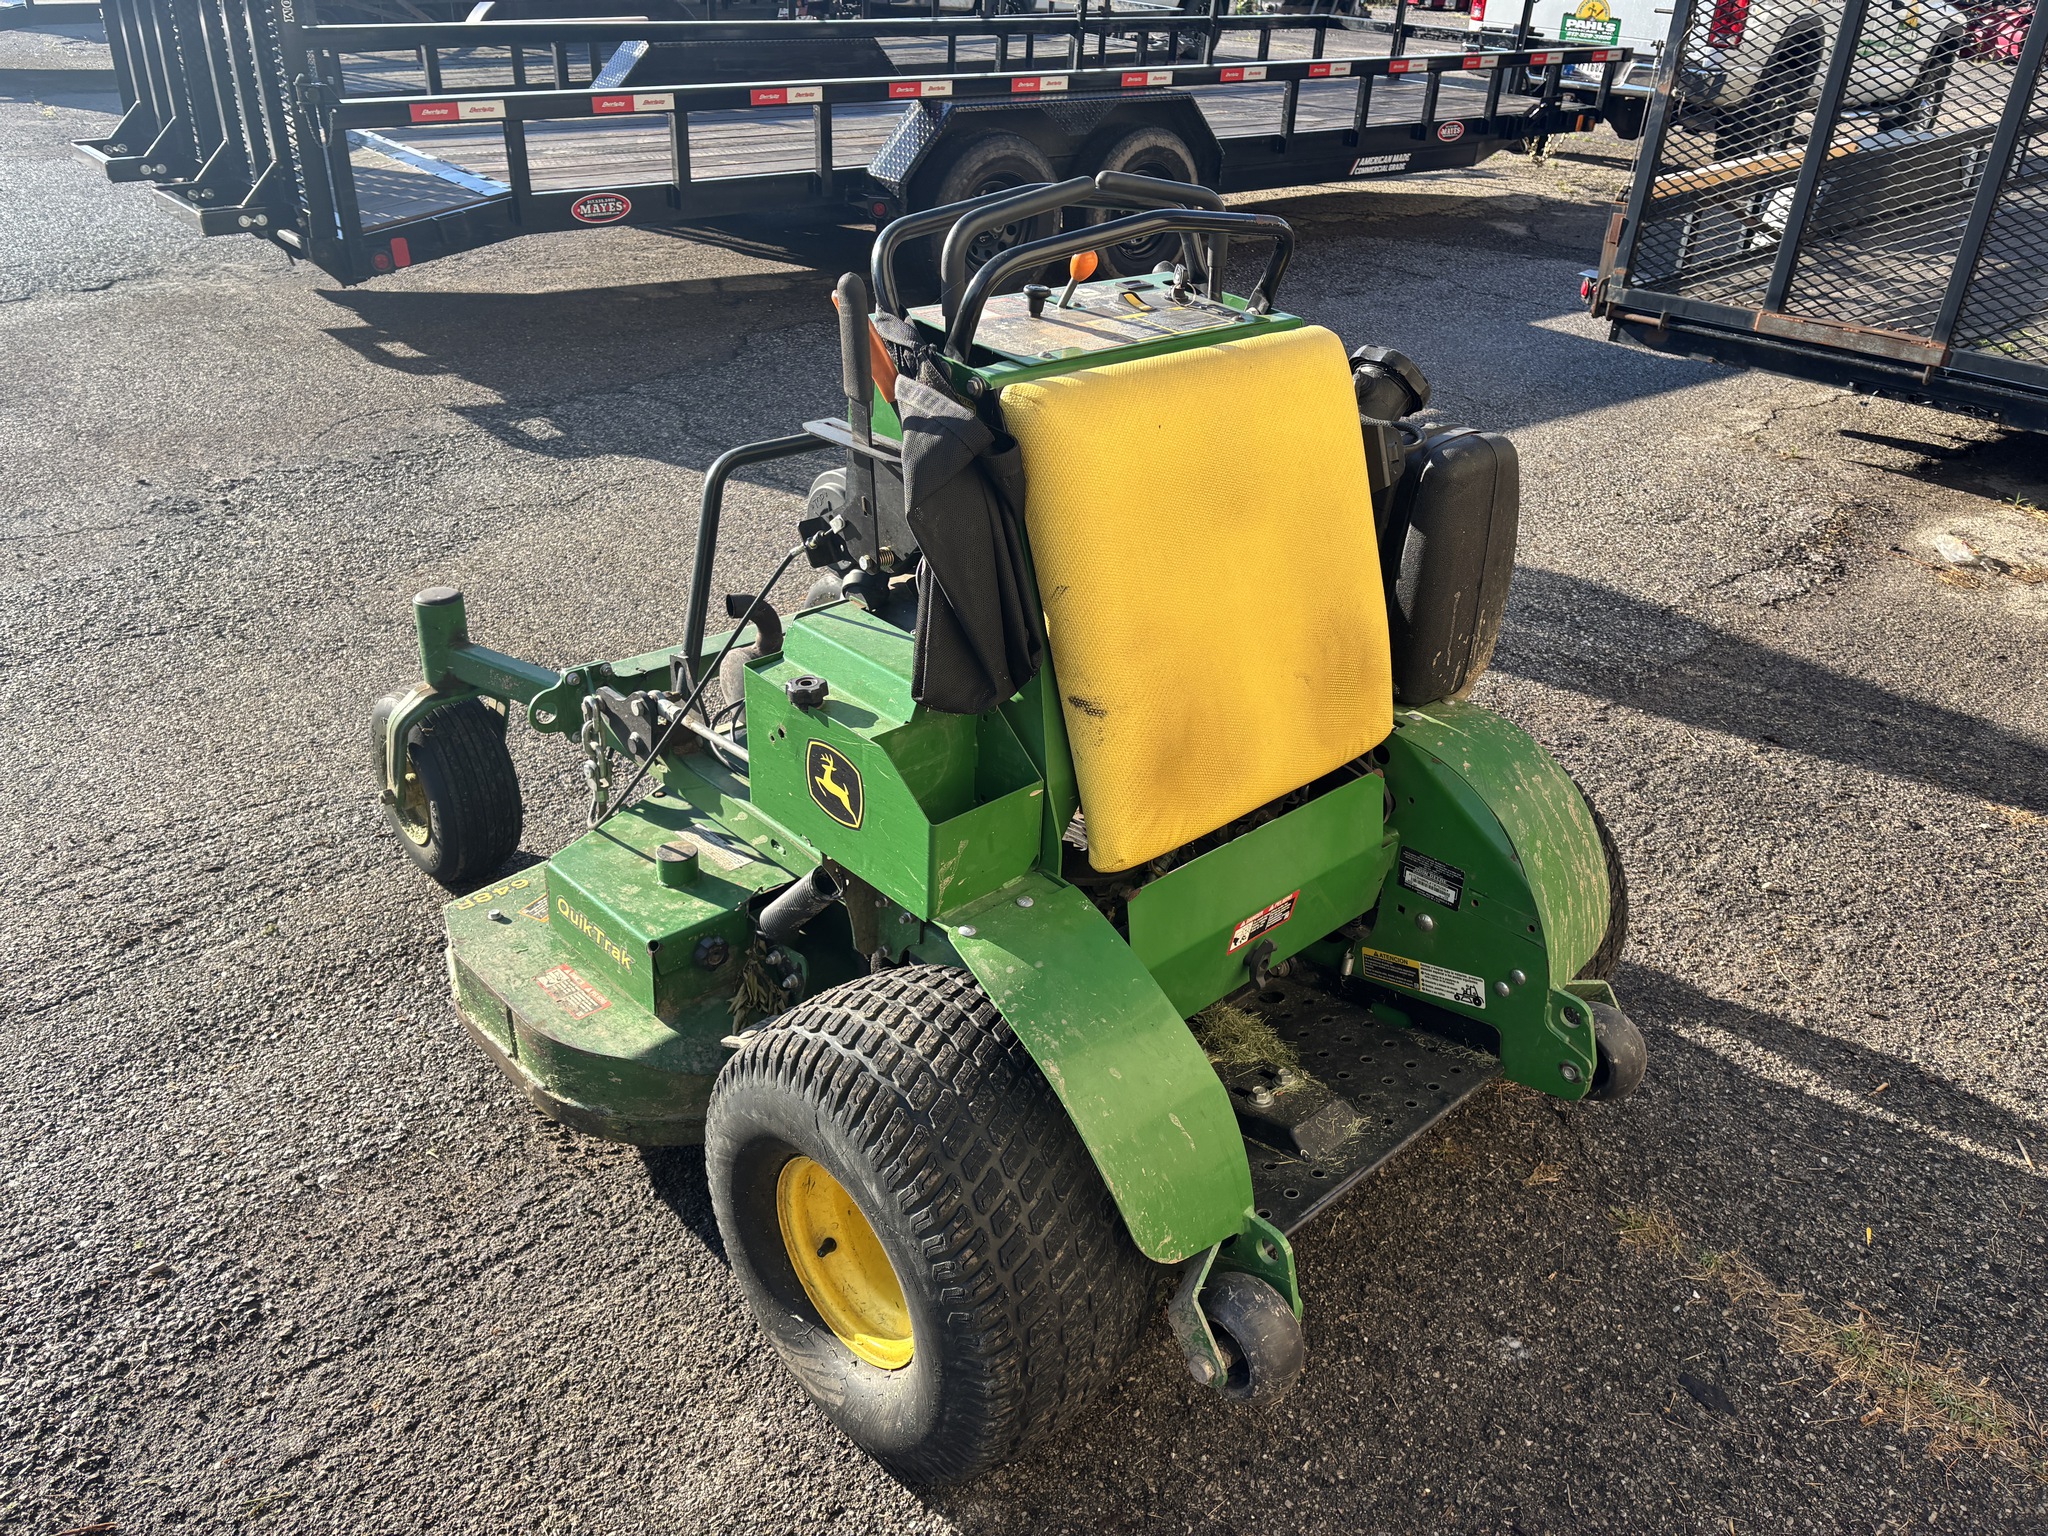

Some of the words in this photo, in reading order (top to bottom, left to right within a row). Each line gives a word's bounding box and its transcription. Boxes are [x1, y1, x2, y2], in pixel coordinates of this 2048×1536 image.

[1566, 19, 1616, 32] PAHL'S
[1359, 155, 1393, 165] AMERICAN
[1391, 153, 1412, 163] MADE
[1354, 164, 1389, 175] COMMERCIAL
[1388, 162, 1407, 171] GRADE
[580, 201, 623, 214] MAYES
[455, 879, 529, 911] 648R
[556, 895, 636, 974] QuikTrak
[1379, 952, 1409, 965] ATENCION
